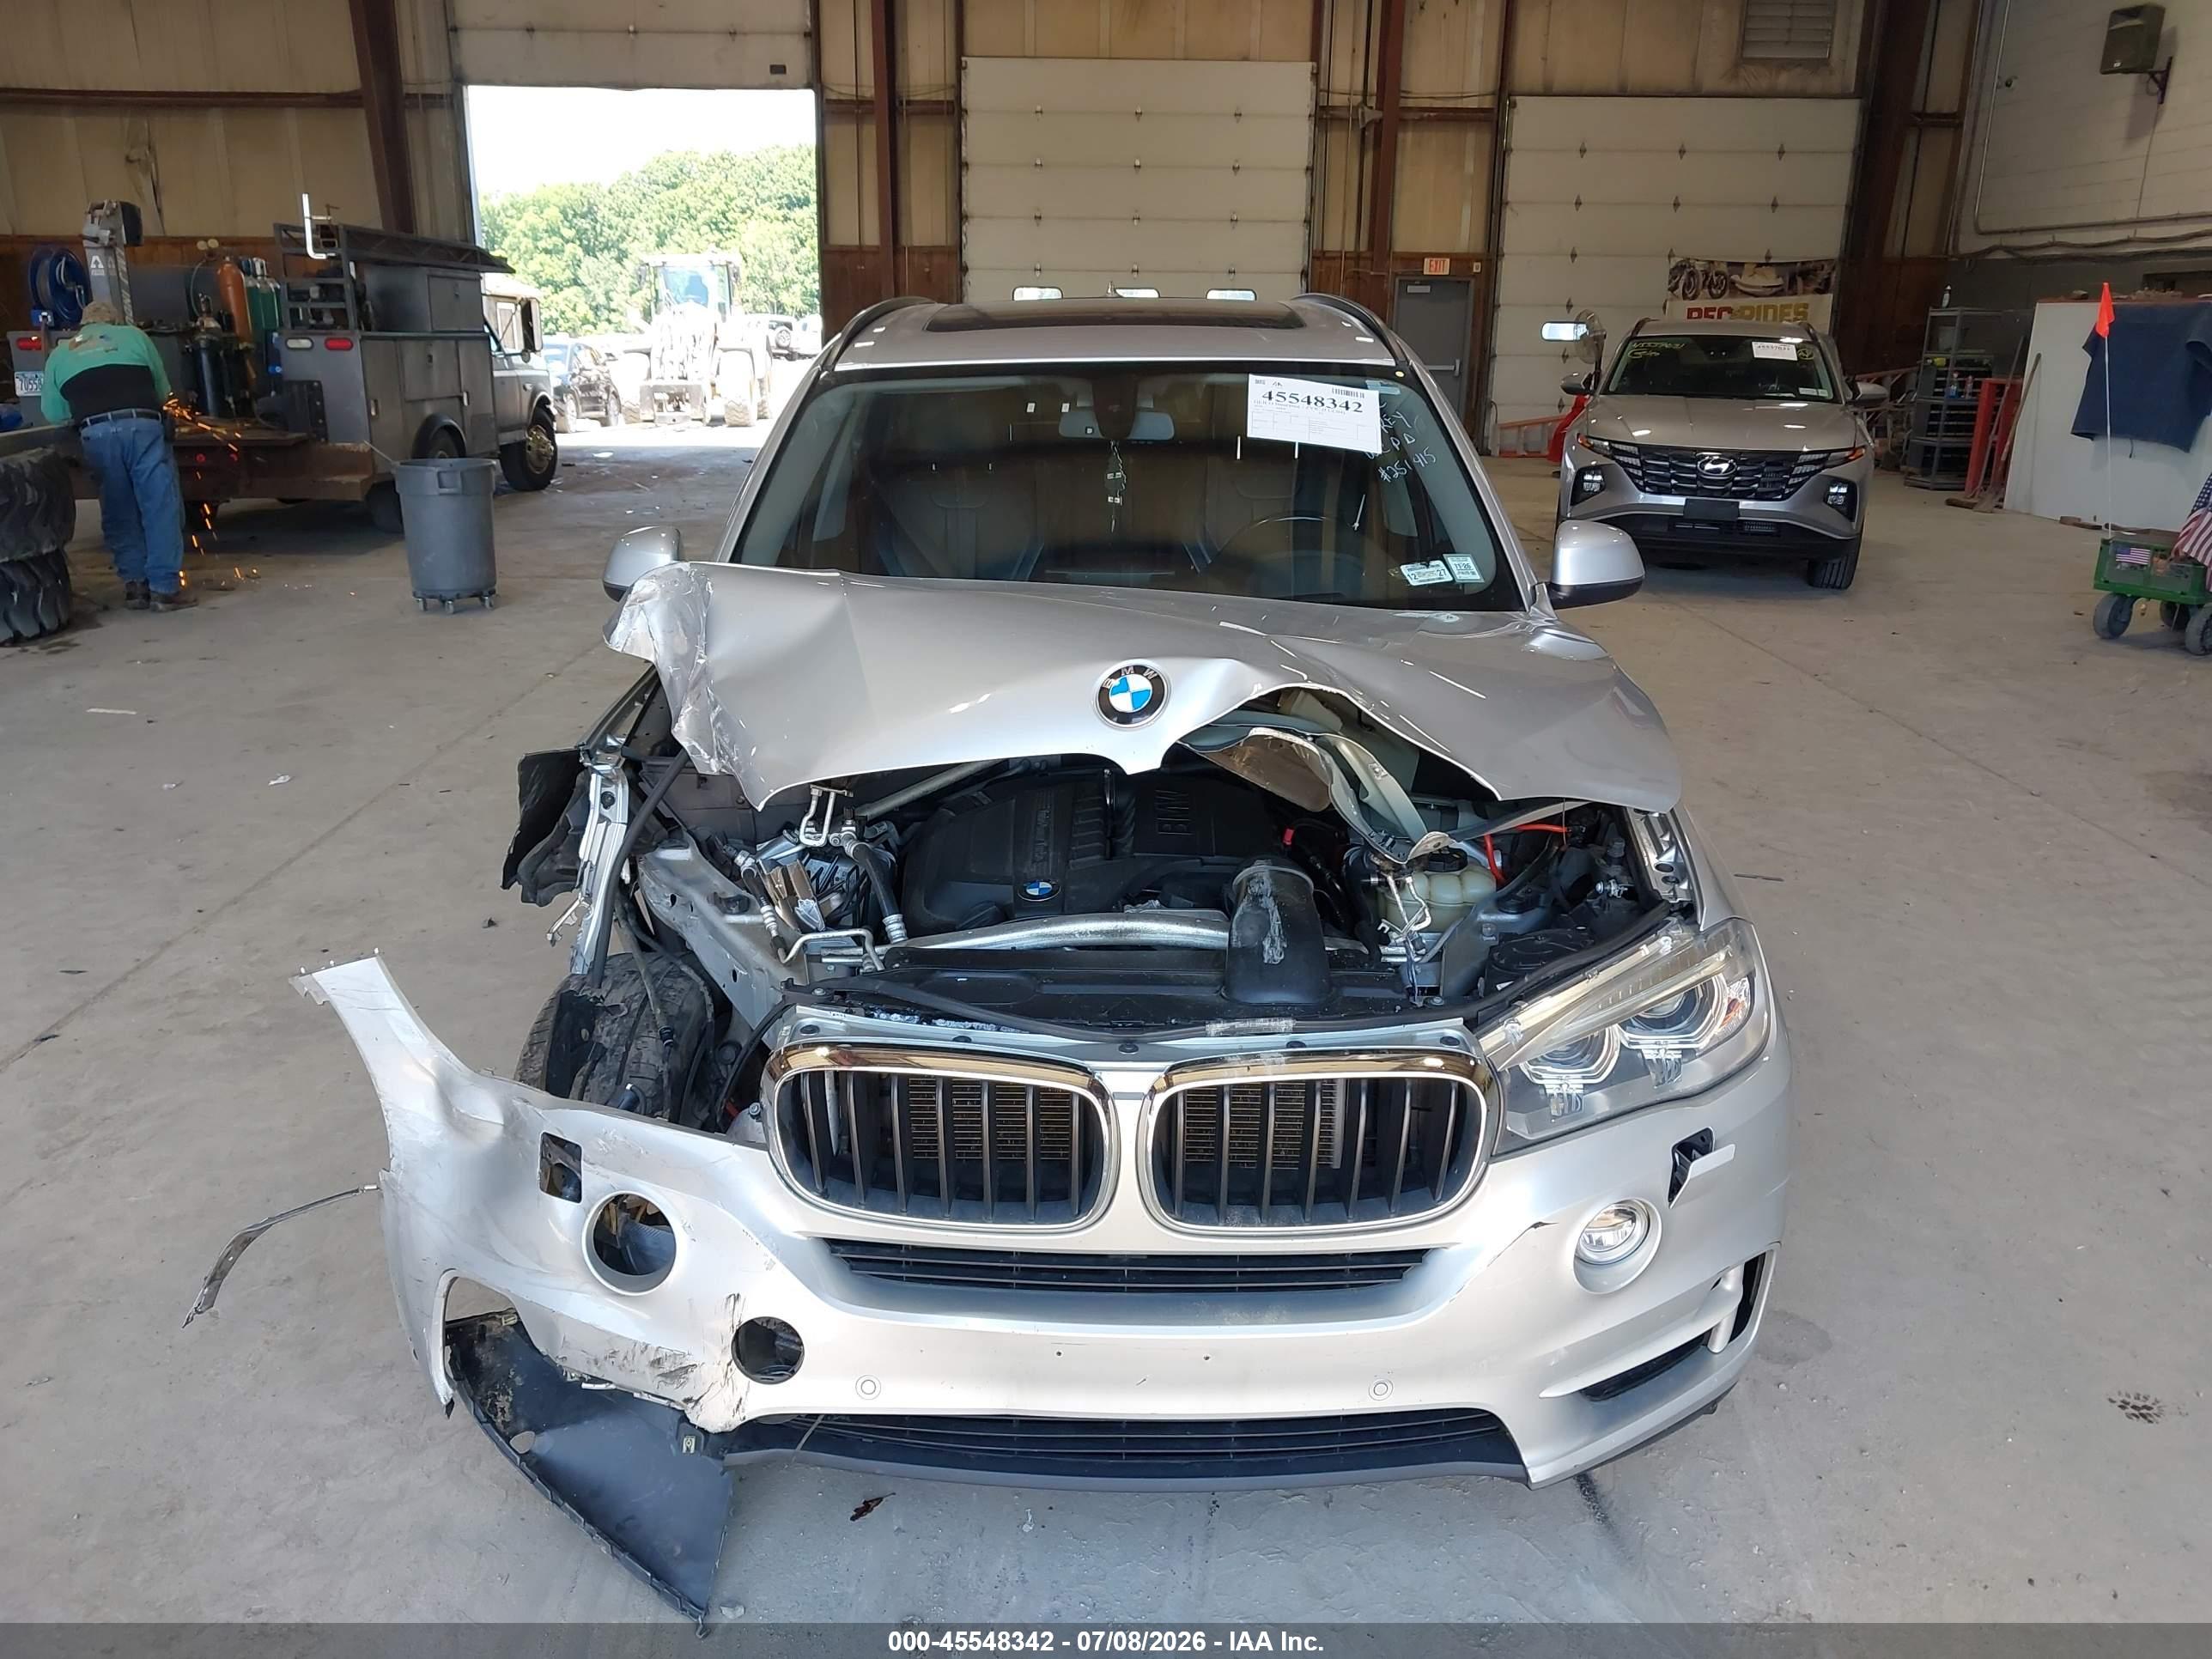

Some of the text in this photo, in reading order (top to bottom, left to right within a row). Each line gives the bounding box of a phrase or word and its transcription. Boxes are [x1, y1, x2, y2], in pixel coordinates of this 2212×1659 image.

[1429, 259, 1447, 272] EXIT
[1262, 390, 1364, 413] 45548342
[1102, 665, 1158, 690] BMW
